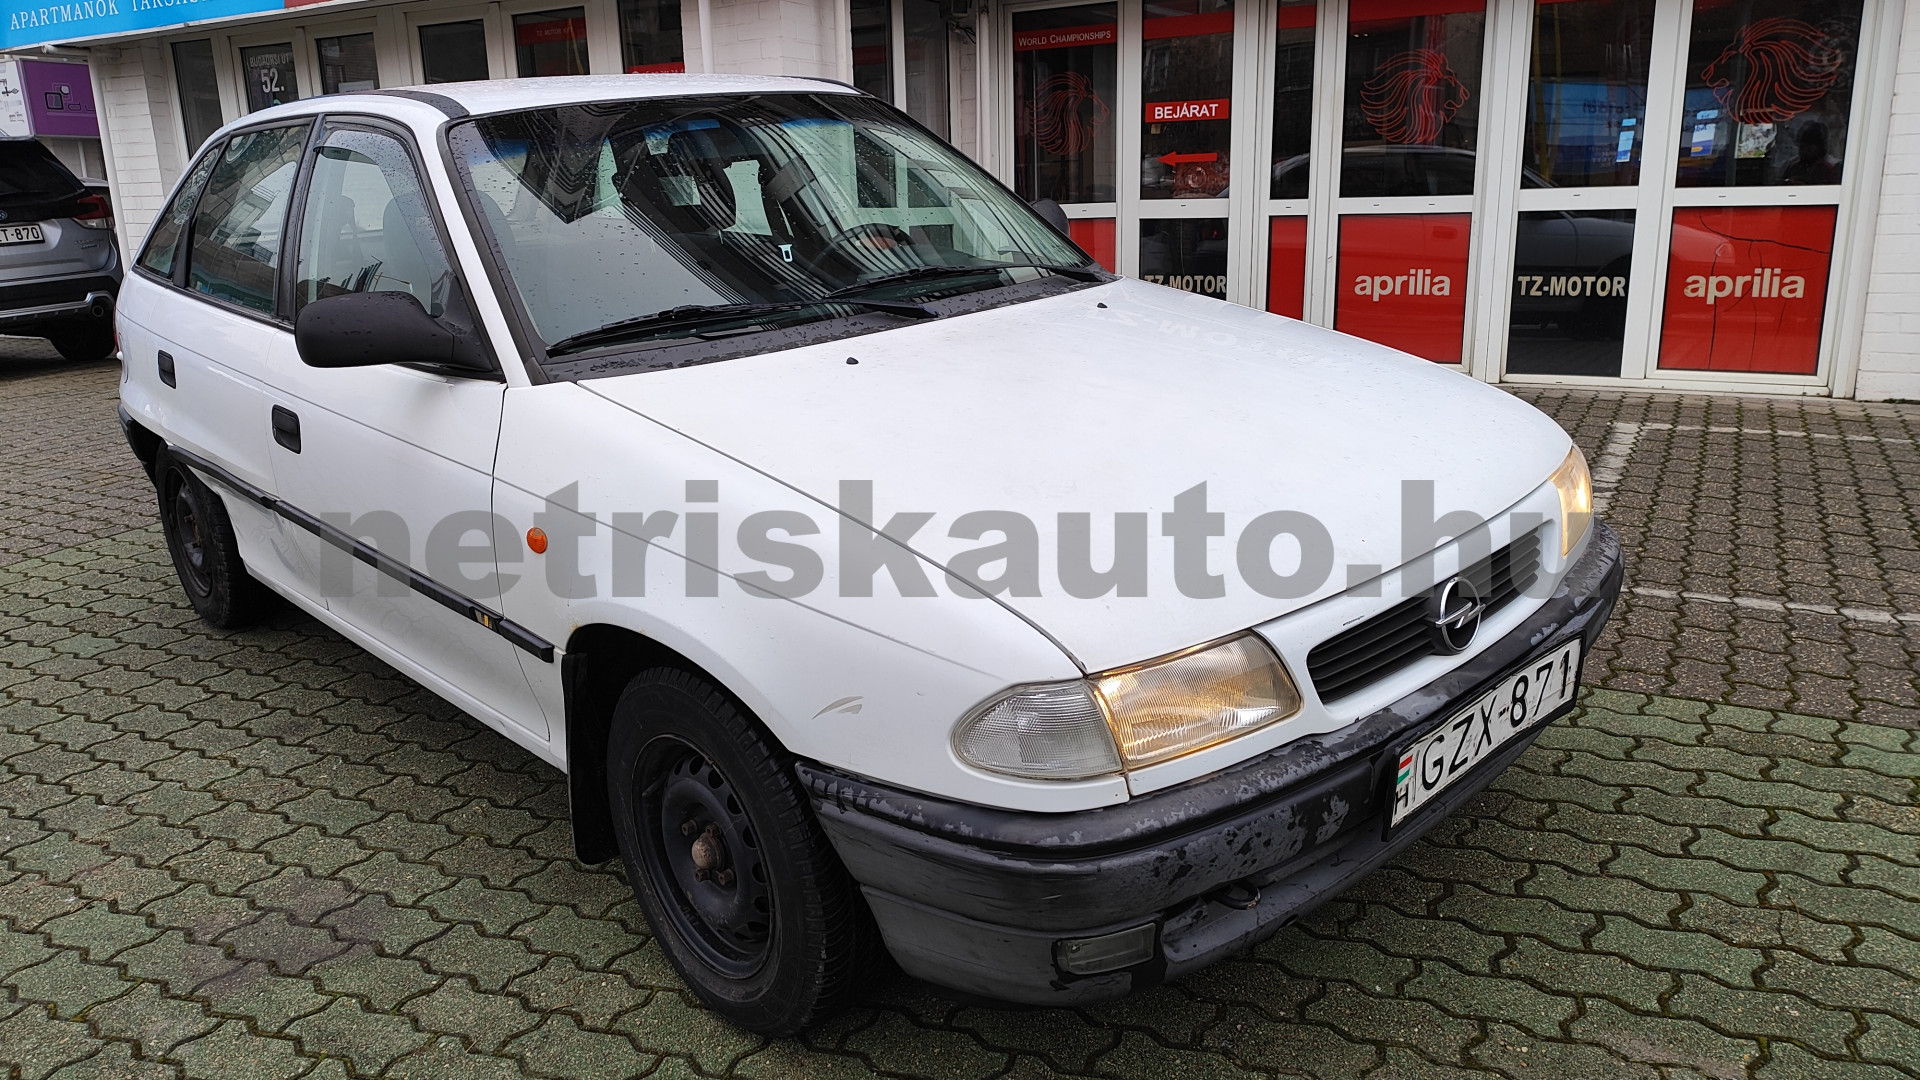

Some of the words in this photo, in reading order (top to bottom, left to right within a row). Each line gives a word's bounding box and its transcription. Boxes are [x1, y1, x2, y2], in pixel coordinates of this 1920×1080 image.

[10, 0, 119, 30] APARTMANOK
[1018, 36, 1047, 47] WORLD
[1050, 30, 1112, 44] CHAMPIONSHIPS
[261, 68, 285, 93] 52.
[1154, 102, 1219, 119] BEJÁRAT
[0, 227, 40, 242] T-870
[1354, 269, 1451, 302] aprilia
[1517, 275, 1626, 297] TZ-MOTOR
[1684, 268, 1806, 305] aprilia
[1421, 648, 1571, 791] GZX-871
